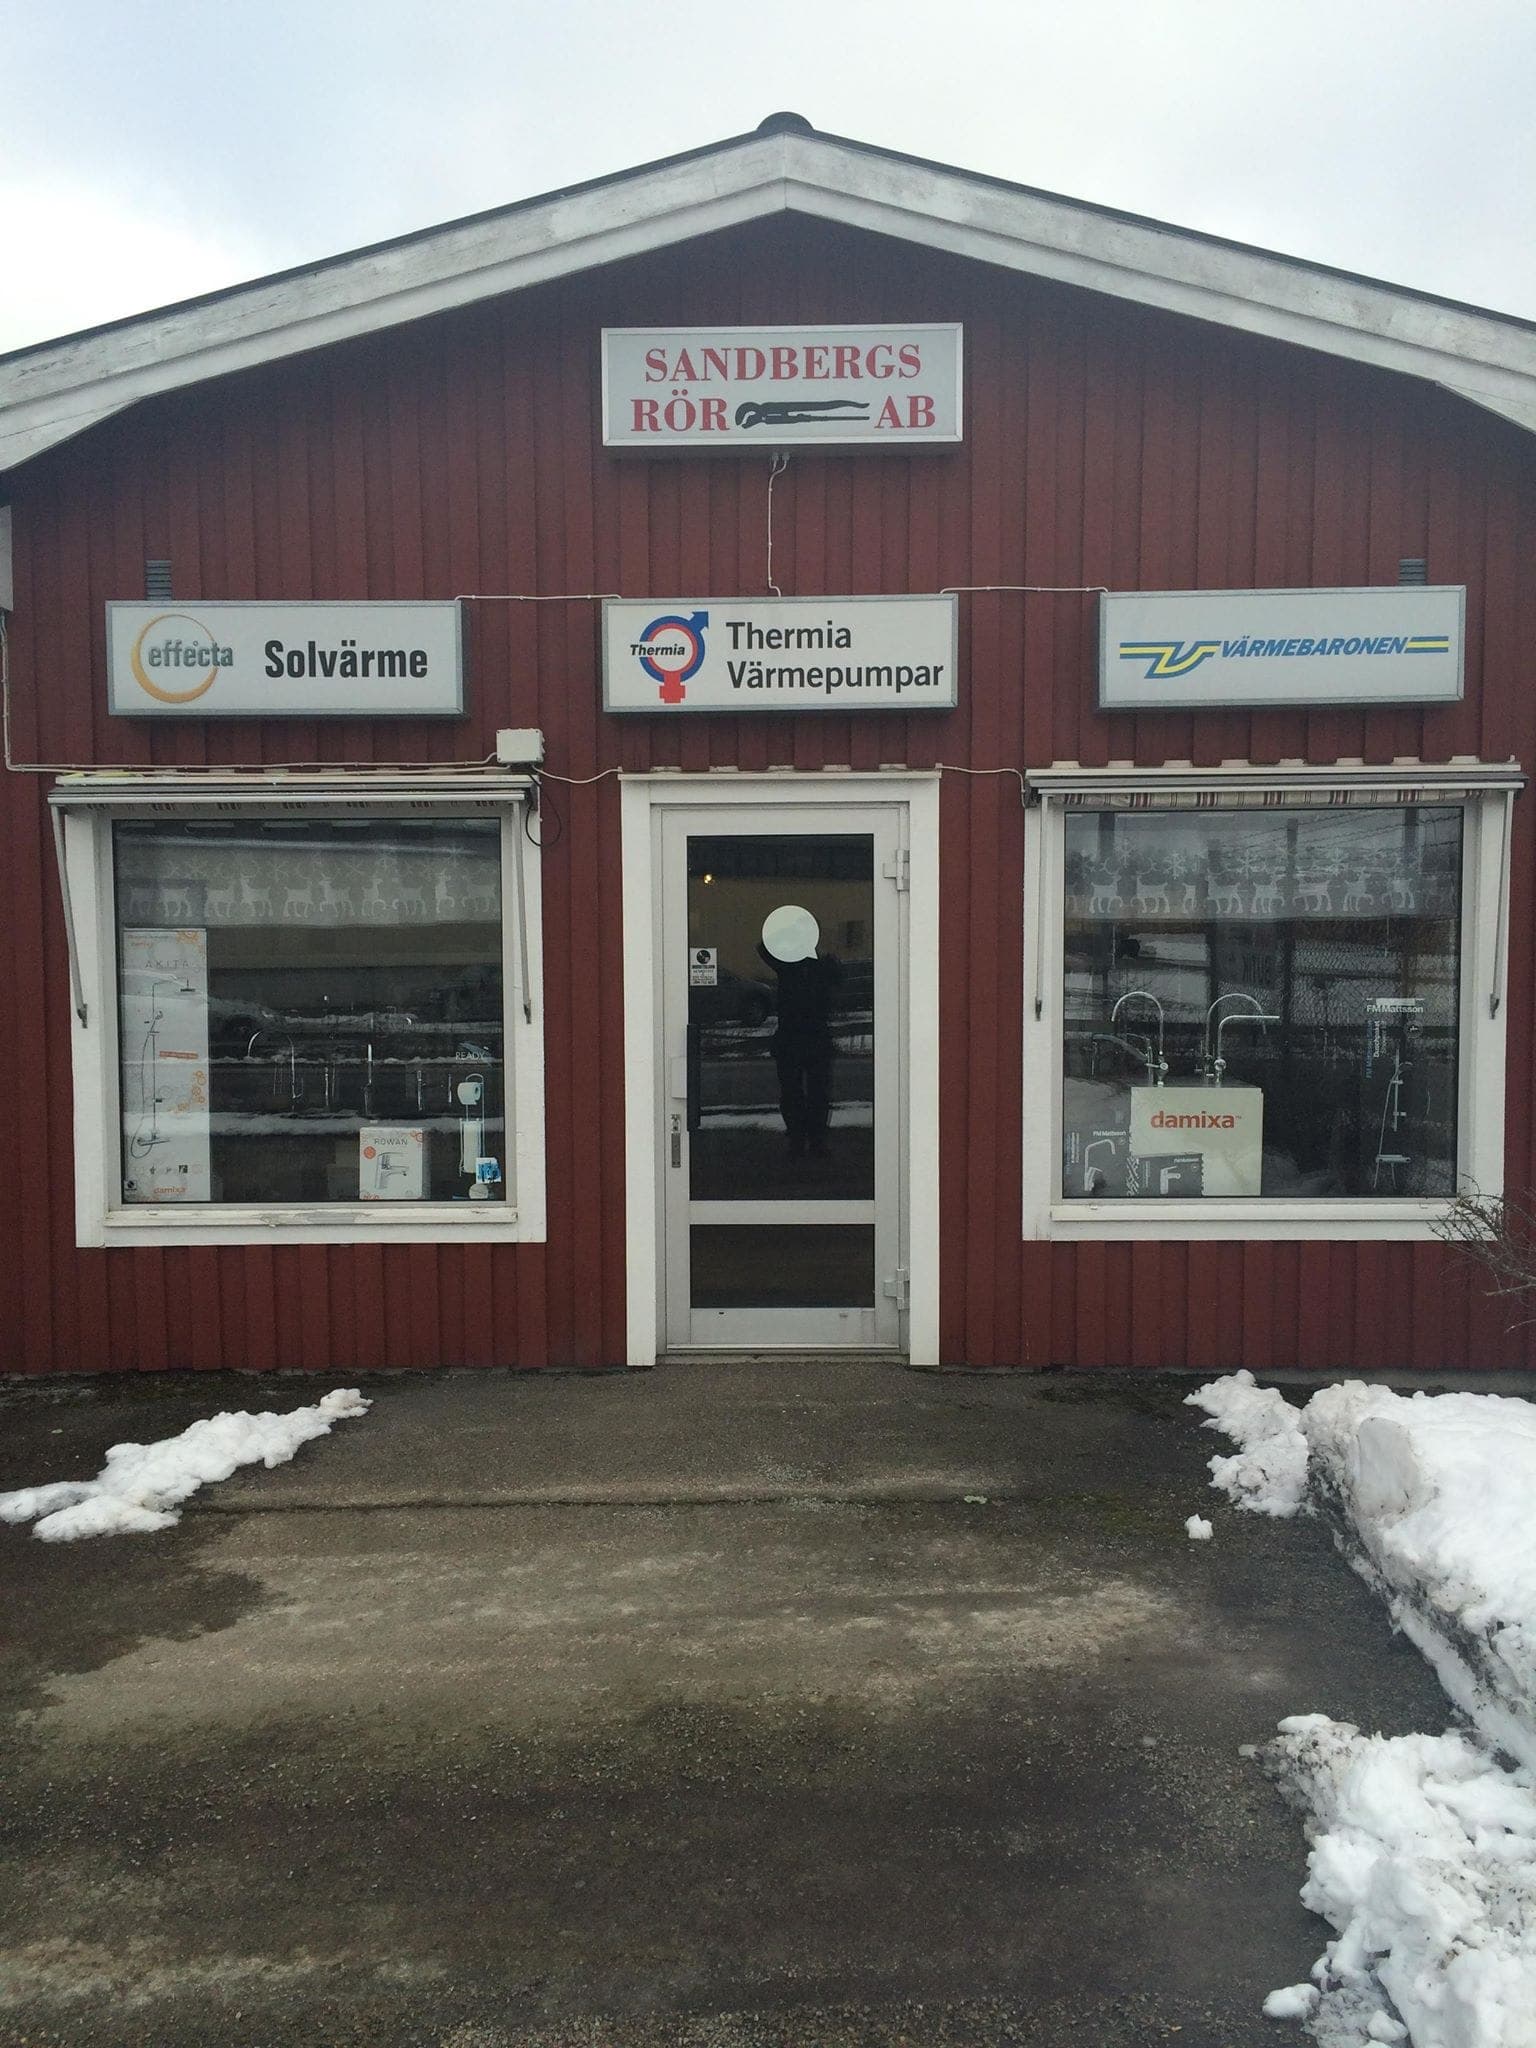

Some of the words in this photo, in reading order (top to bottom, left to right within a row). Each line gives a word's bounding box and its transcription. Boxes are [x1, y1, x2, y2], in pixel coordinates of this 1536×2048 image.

[645, 343, 921, 383] SANDBERGS
[630, 388, 730, 432] RÖR
[873, 395, 936, 430] AB
[726, 620, 852, 650] Thermia
[1221, 635, 1409, 658] VÄRMEBARONEN
[148, 639, 234, 668] effecta
[264, 639, 428, 678] Solvärme
[630, 643, 686, 657] Thermia
[726, 660, 944, 695] Värmepumpar
[455, 1051, 485, 1061] READY
[1150, 1110, 1235, 1129] damixa
[374, 1138, 409, 1146] ROWAN
